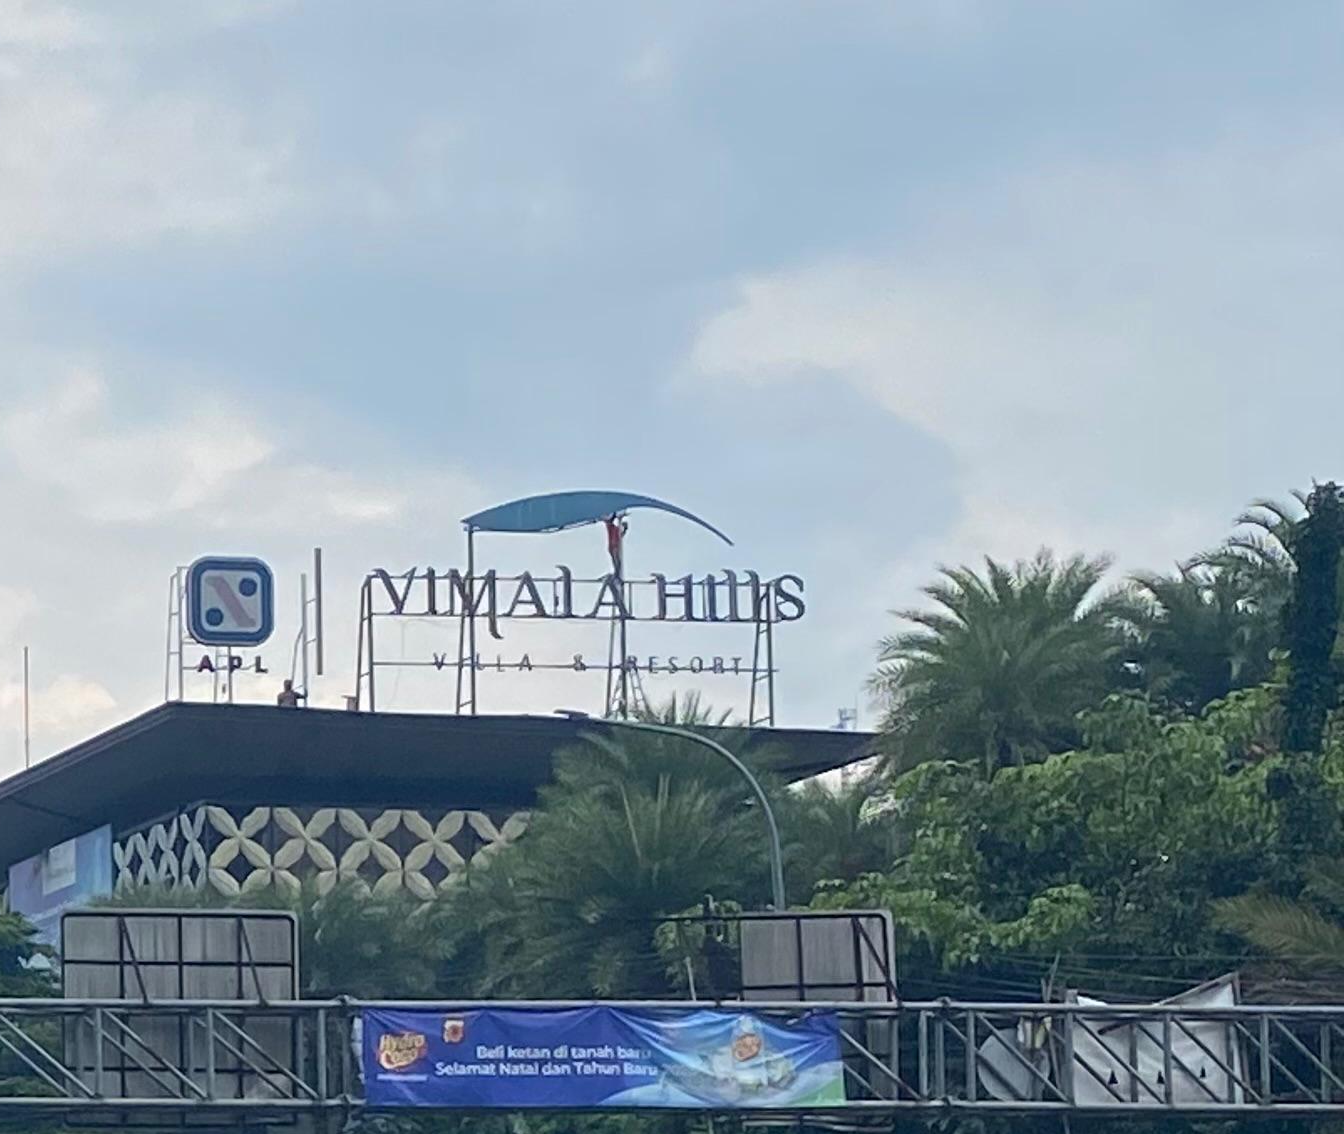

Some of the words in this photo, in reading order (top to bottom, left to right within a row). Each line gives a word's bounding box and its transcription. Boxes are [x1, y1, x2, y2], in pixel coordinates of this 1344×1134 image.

[197, 654, 269, 674] APL
[433, 652, 533, 673] VLLA
[624, 655, 742, 676] RESORT
[435, 1061, 496, 1076] Selamat
[499, 1062, 539, 1075] Natal
[541, 1062, 571, 1075] dan
[573, 1062, 621, 1075] Tahun
[623, 1063, 658, 1076] Baru
